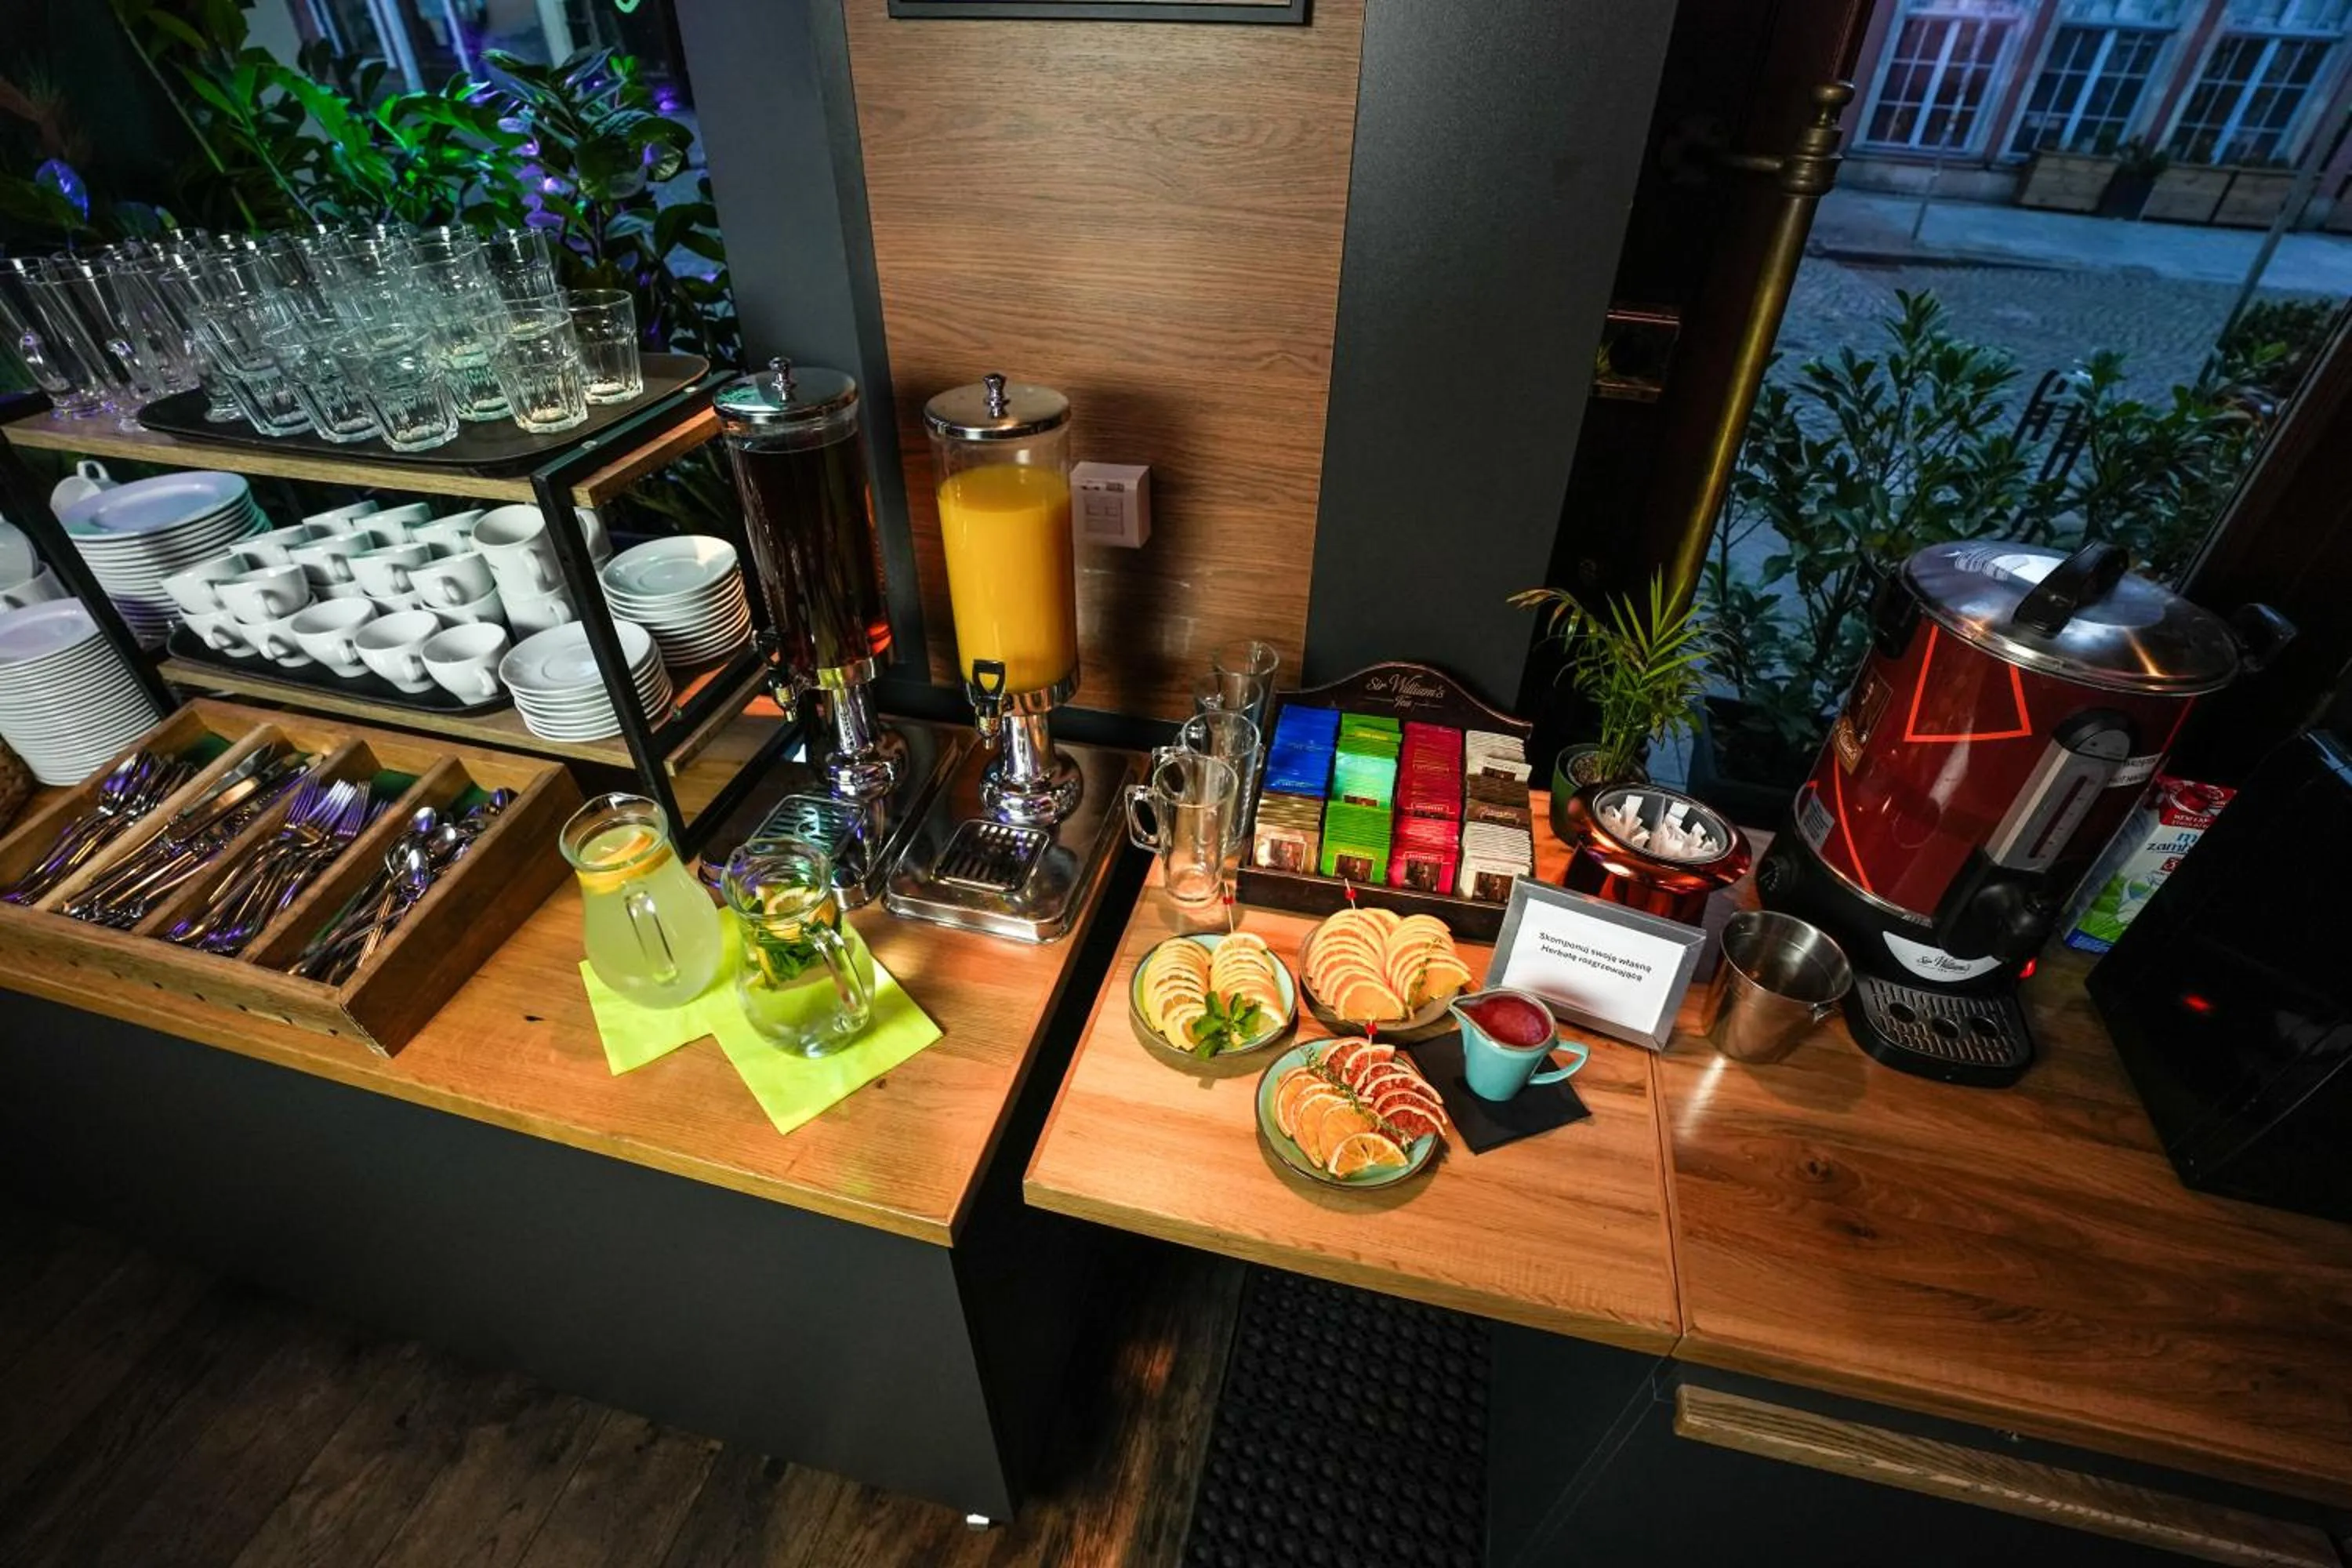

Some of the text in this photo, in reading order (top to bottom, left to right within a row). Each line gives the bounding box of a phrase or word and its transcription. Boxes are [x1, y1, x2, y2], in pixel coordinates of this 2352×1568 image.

[1365, 673, 1446, 699] Sir William's
[1539, 932, 1588, 954] Skomponuj
[1541, 944, 1642, 982] Herbatę rozgrzewającą
